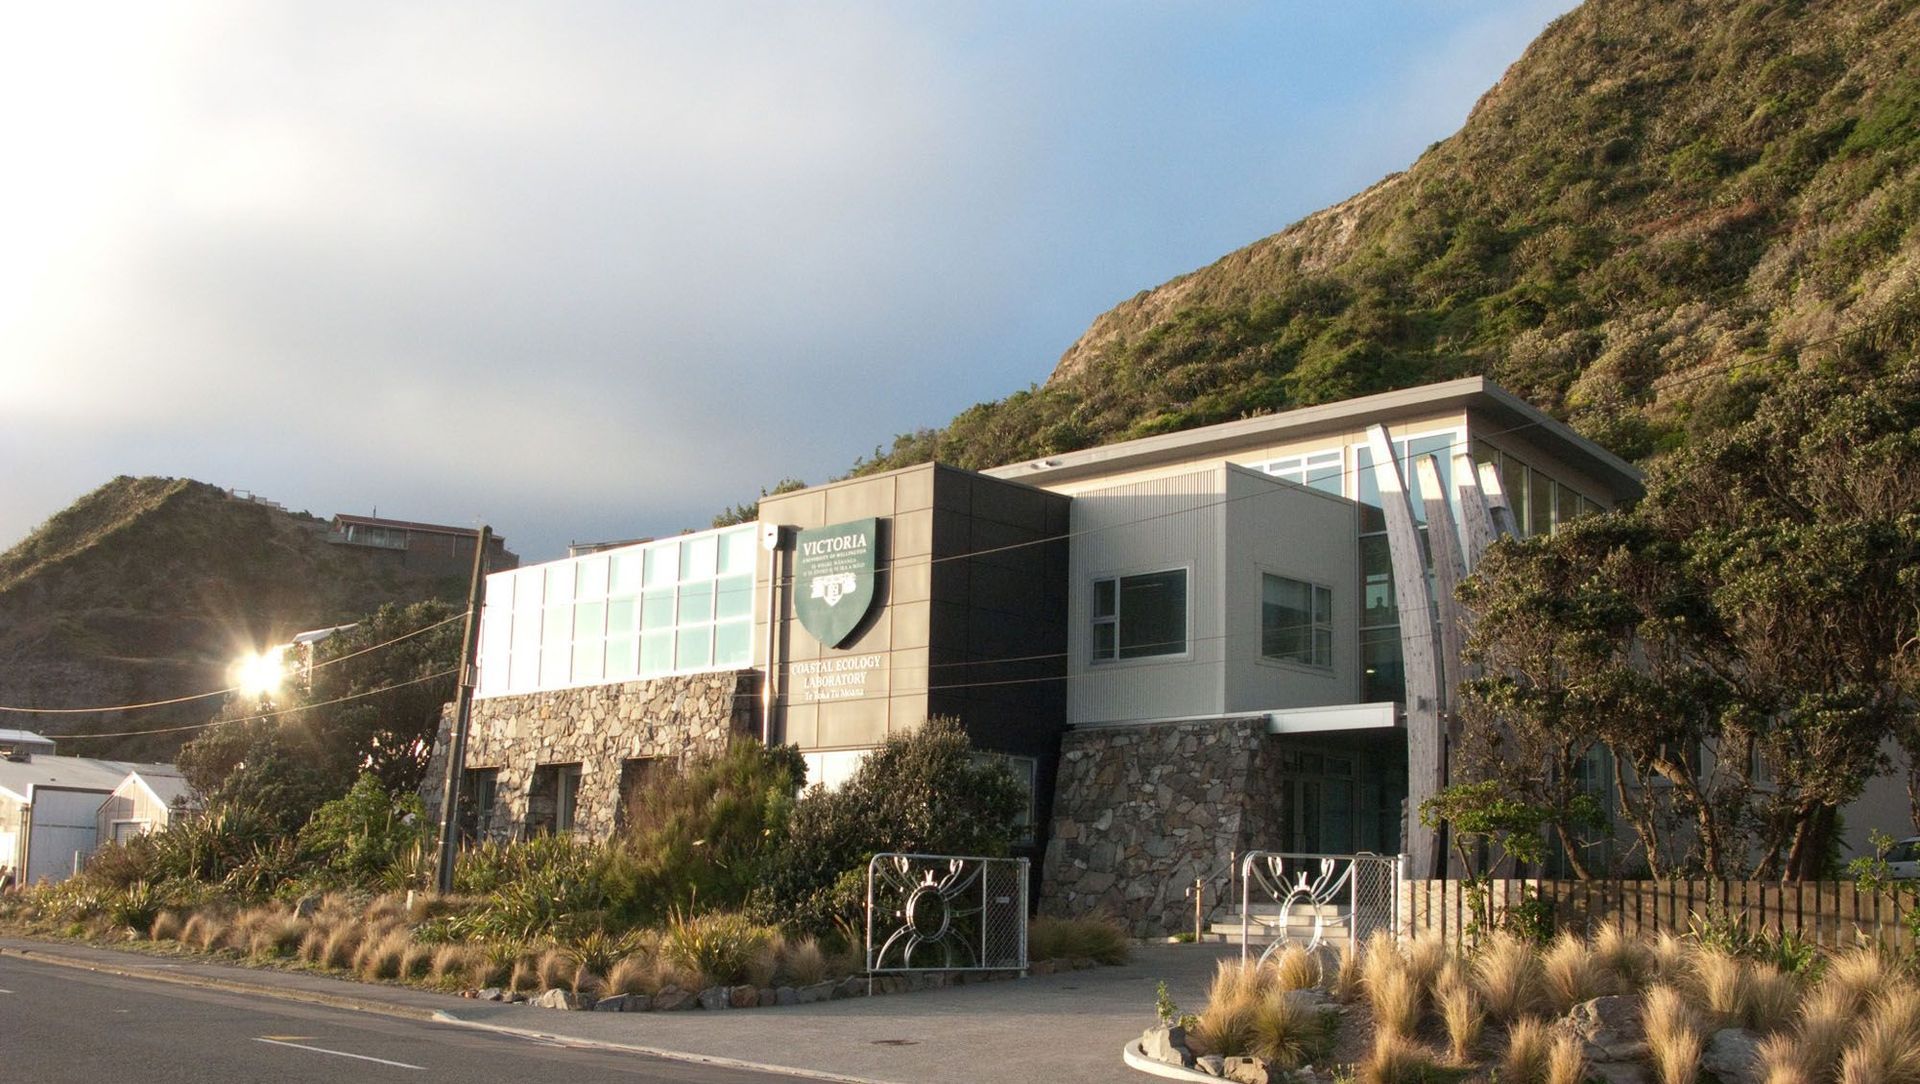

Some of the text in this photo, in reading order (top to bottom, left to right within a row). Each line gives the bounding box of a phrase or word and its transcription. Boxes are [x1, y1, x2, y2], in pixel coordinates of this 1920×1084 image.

[803, 533, 867, 556] VICTORIA
[791, 656, 881, 675] COASTAL ECOLOGY
[804, 671, 867, 688] LABORATORY
